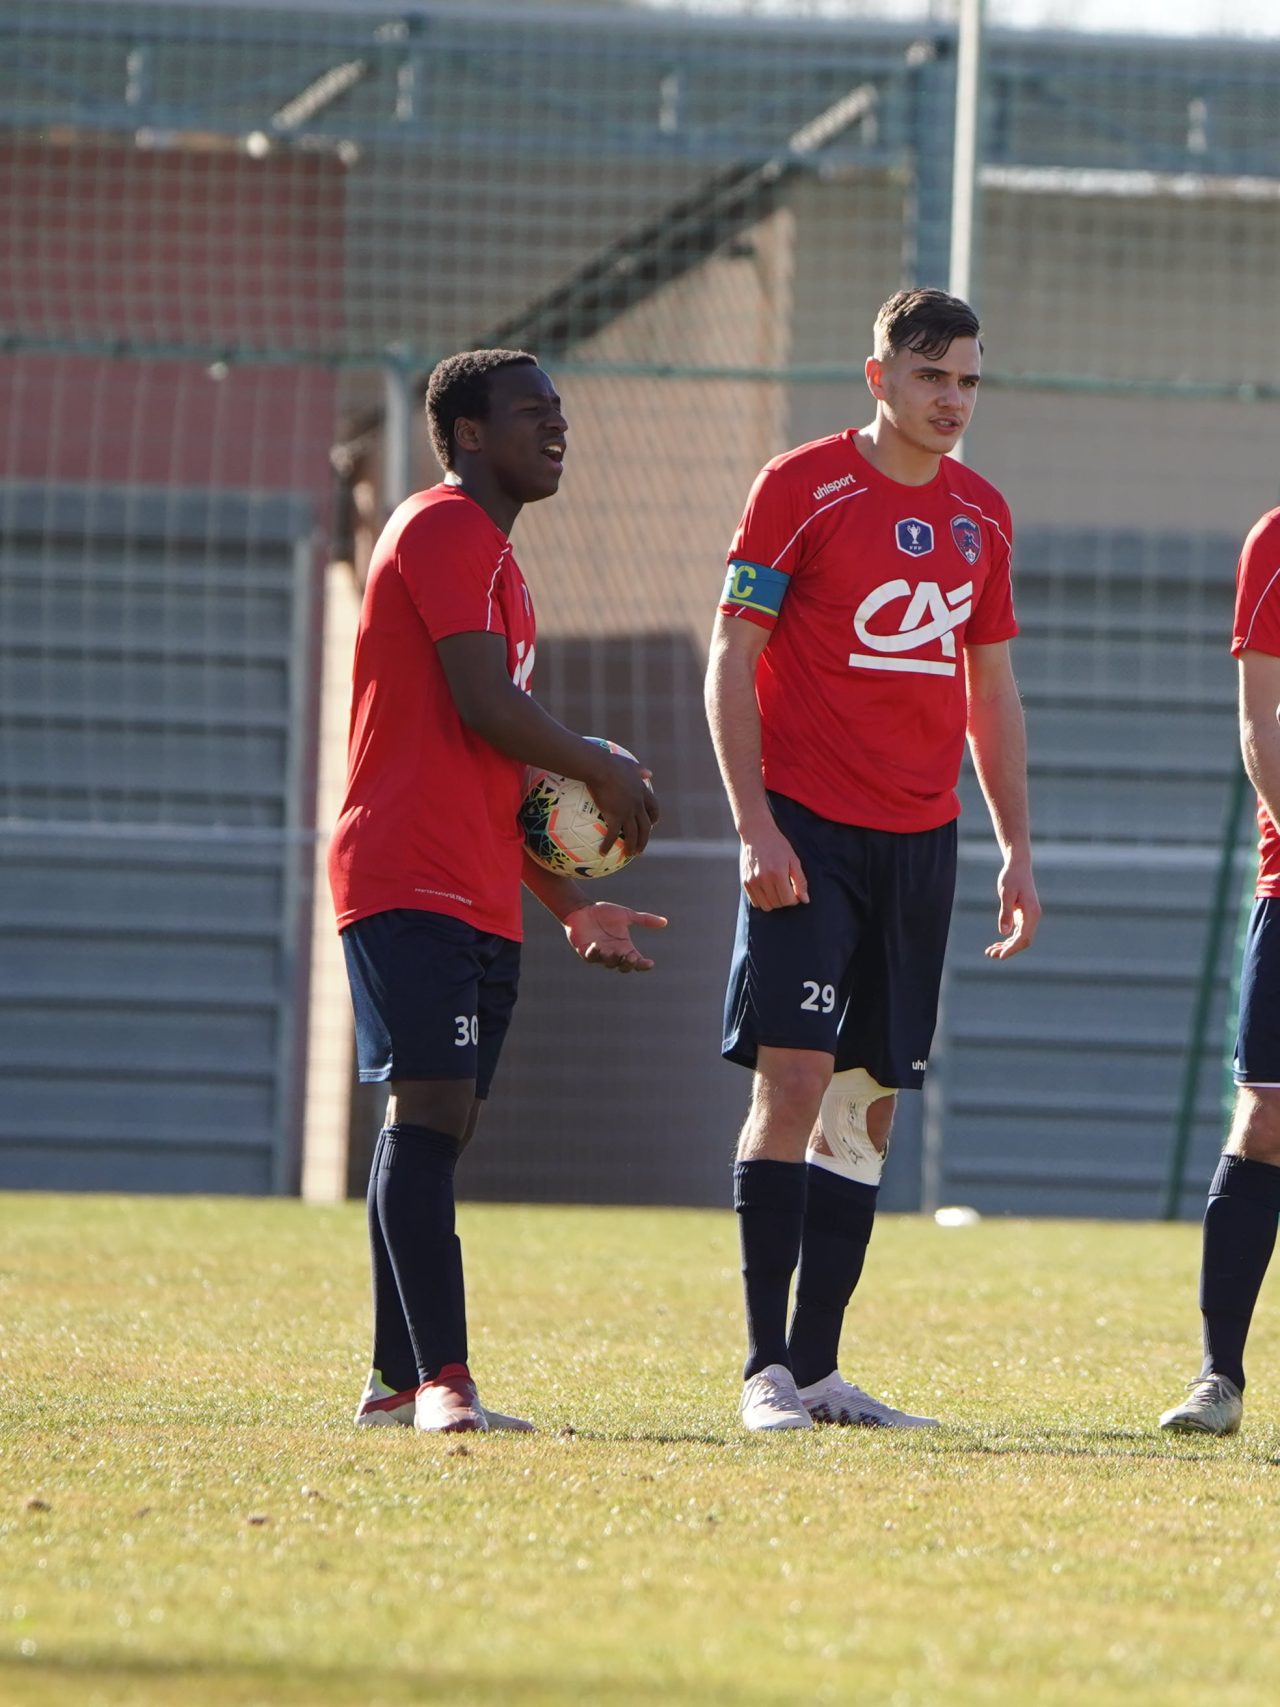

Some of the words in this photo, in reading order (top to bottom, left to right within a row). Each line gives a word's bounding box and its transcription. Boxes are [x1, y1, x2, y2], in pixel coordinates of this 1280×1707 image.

[813, 473, 857, 501] uhlsport
[732, 566, 757, 598] C
[800, 980, 836, 1014] 29
[454, 1015, 479, 1047] 30
